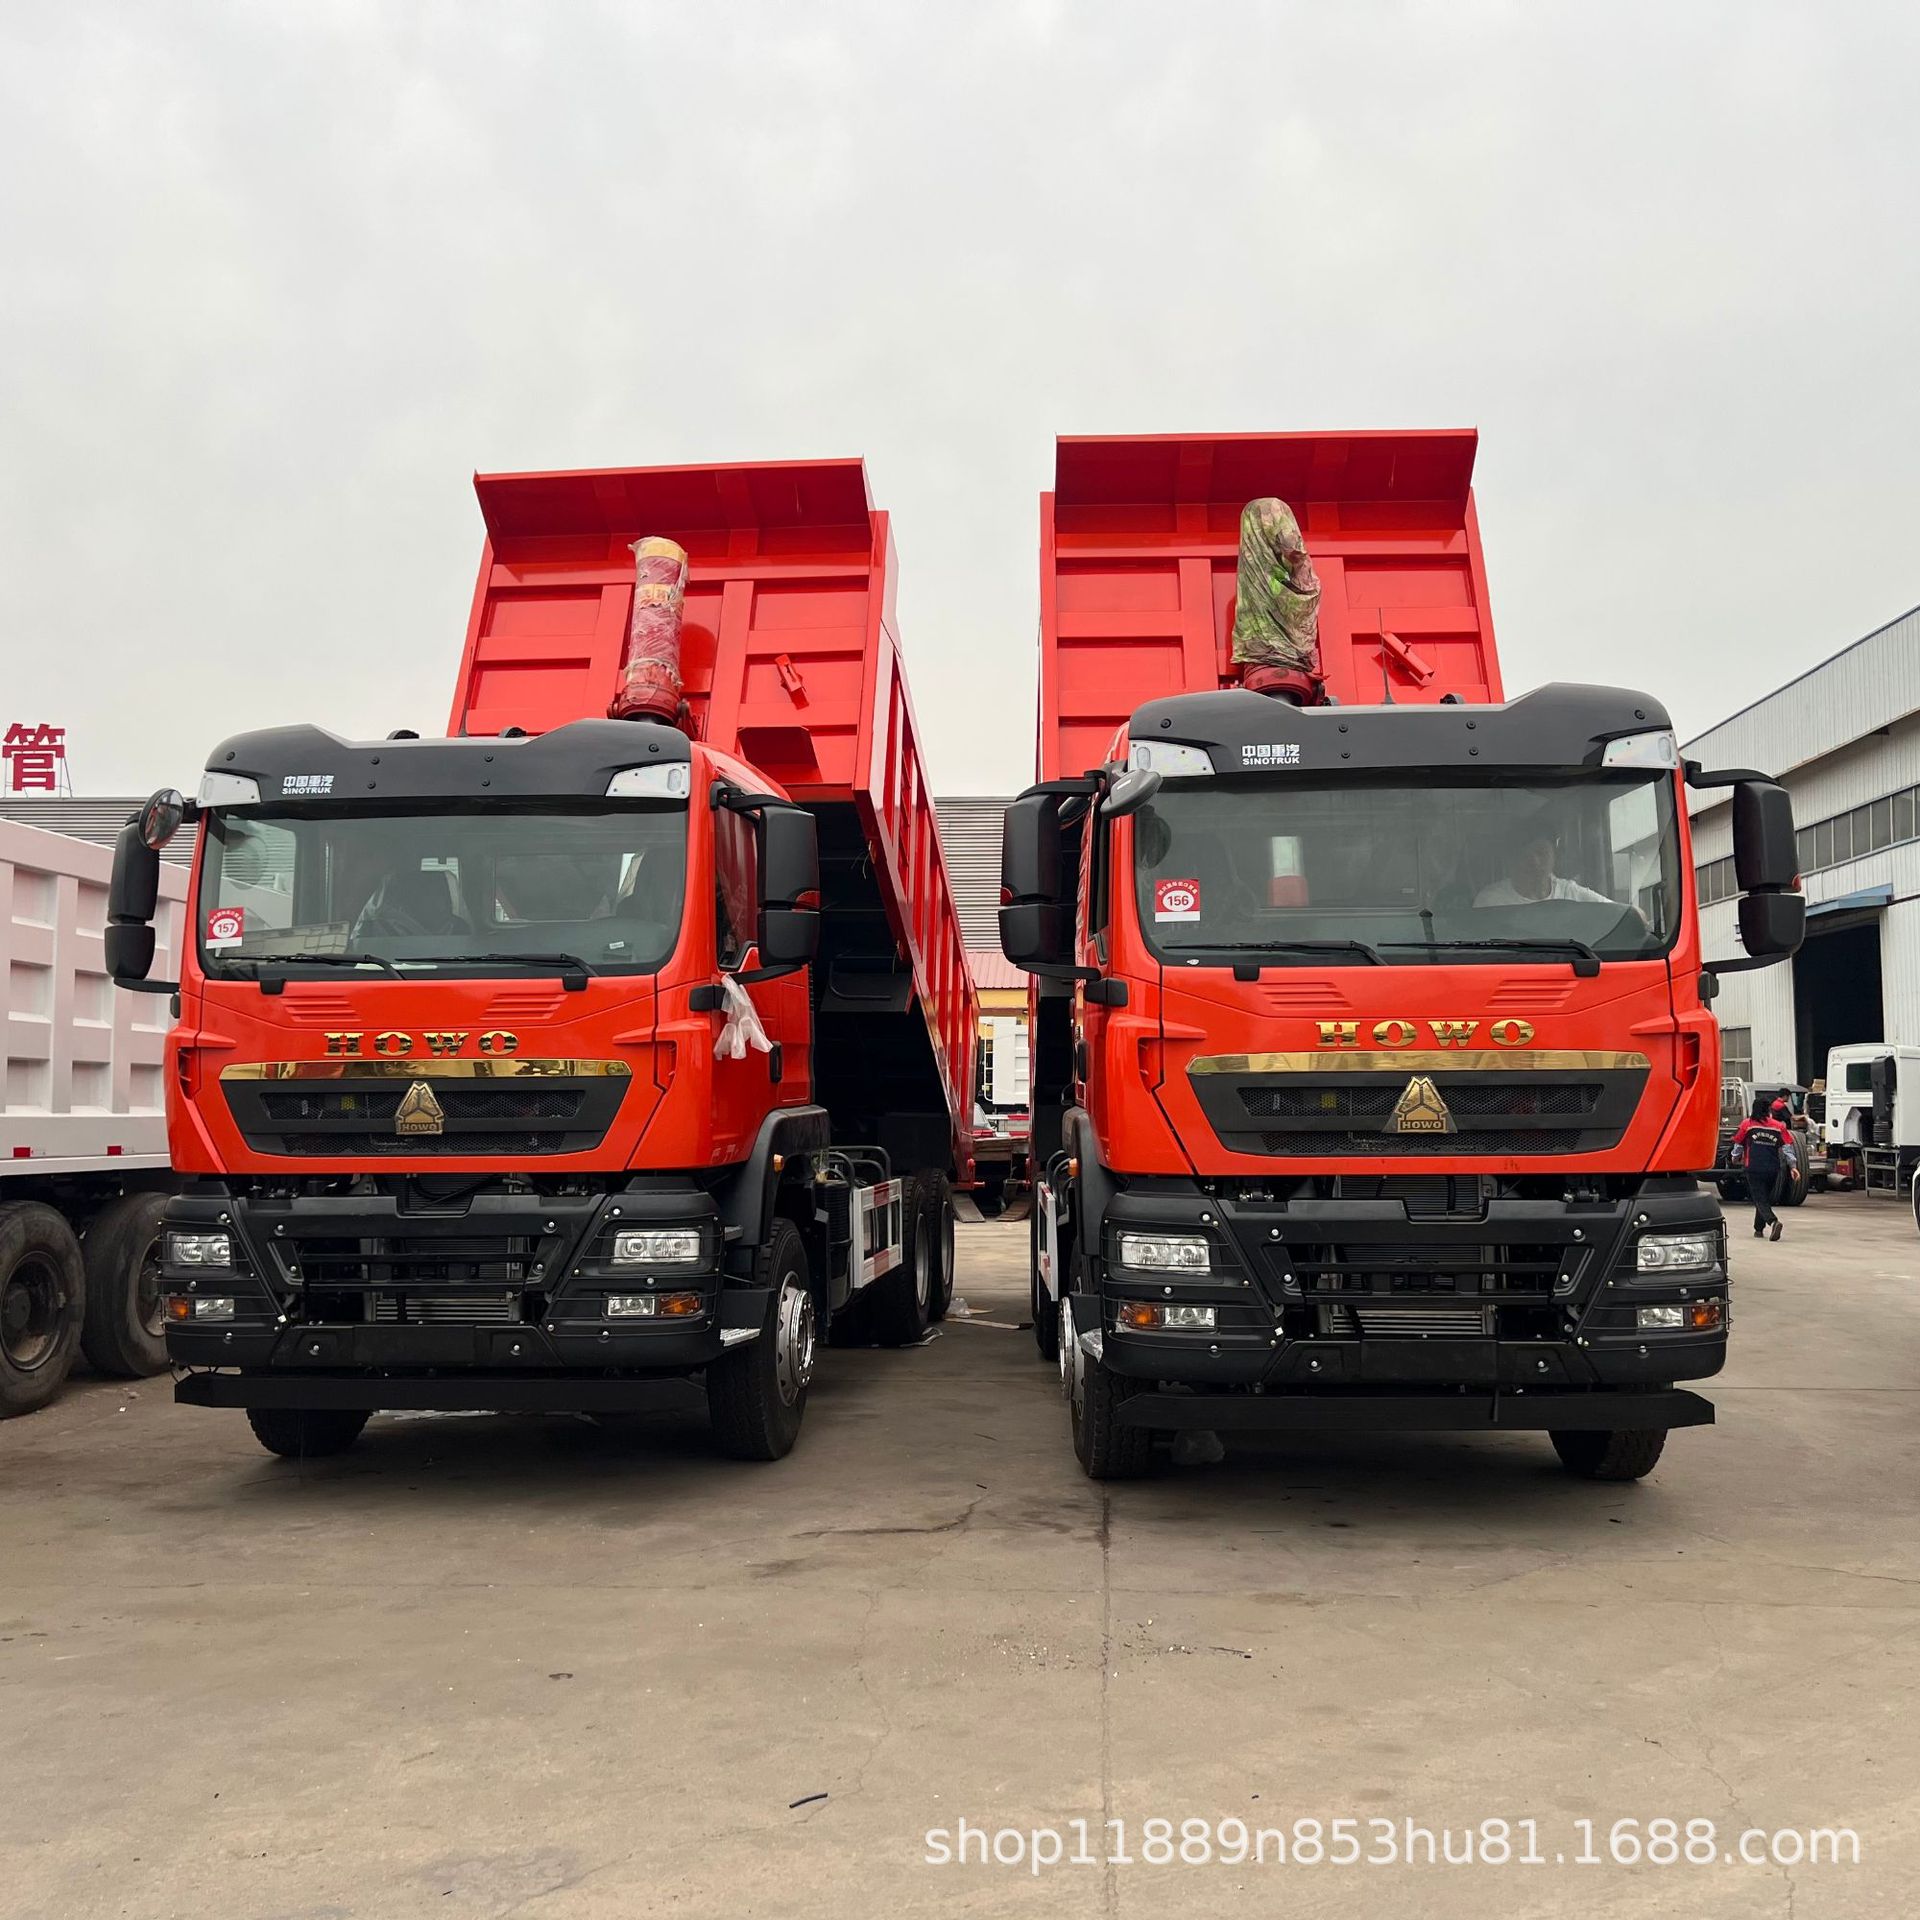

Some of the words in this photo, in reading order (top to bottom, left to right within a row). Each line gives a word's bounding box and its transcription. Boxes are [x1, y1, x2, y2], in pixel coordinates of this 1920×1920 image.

[2, 722, 65, 791] 管
[1242, 744, 1300, 758] 中国重汽
[1242, 757, 1300, 765] SINOTRUK
[283, 775, 335, 787] 中国重汽
[281, 787, 332, 795] SINOTRUK
[1167, 895, 1189, 906] 156
[217, 922, 235, 933] 157
[1315, 1019, 1535, 1048] HOWO
[323, 1030, 519, 1057] HOWO
[401, 1123, 438, 1132] HOWO
[1402, 1121, 1442, 1129] HOWO
